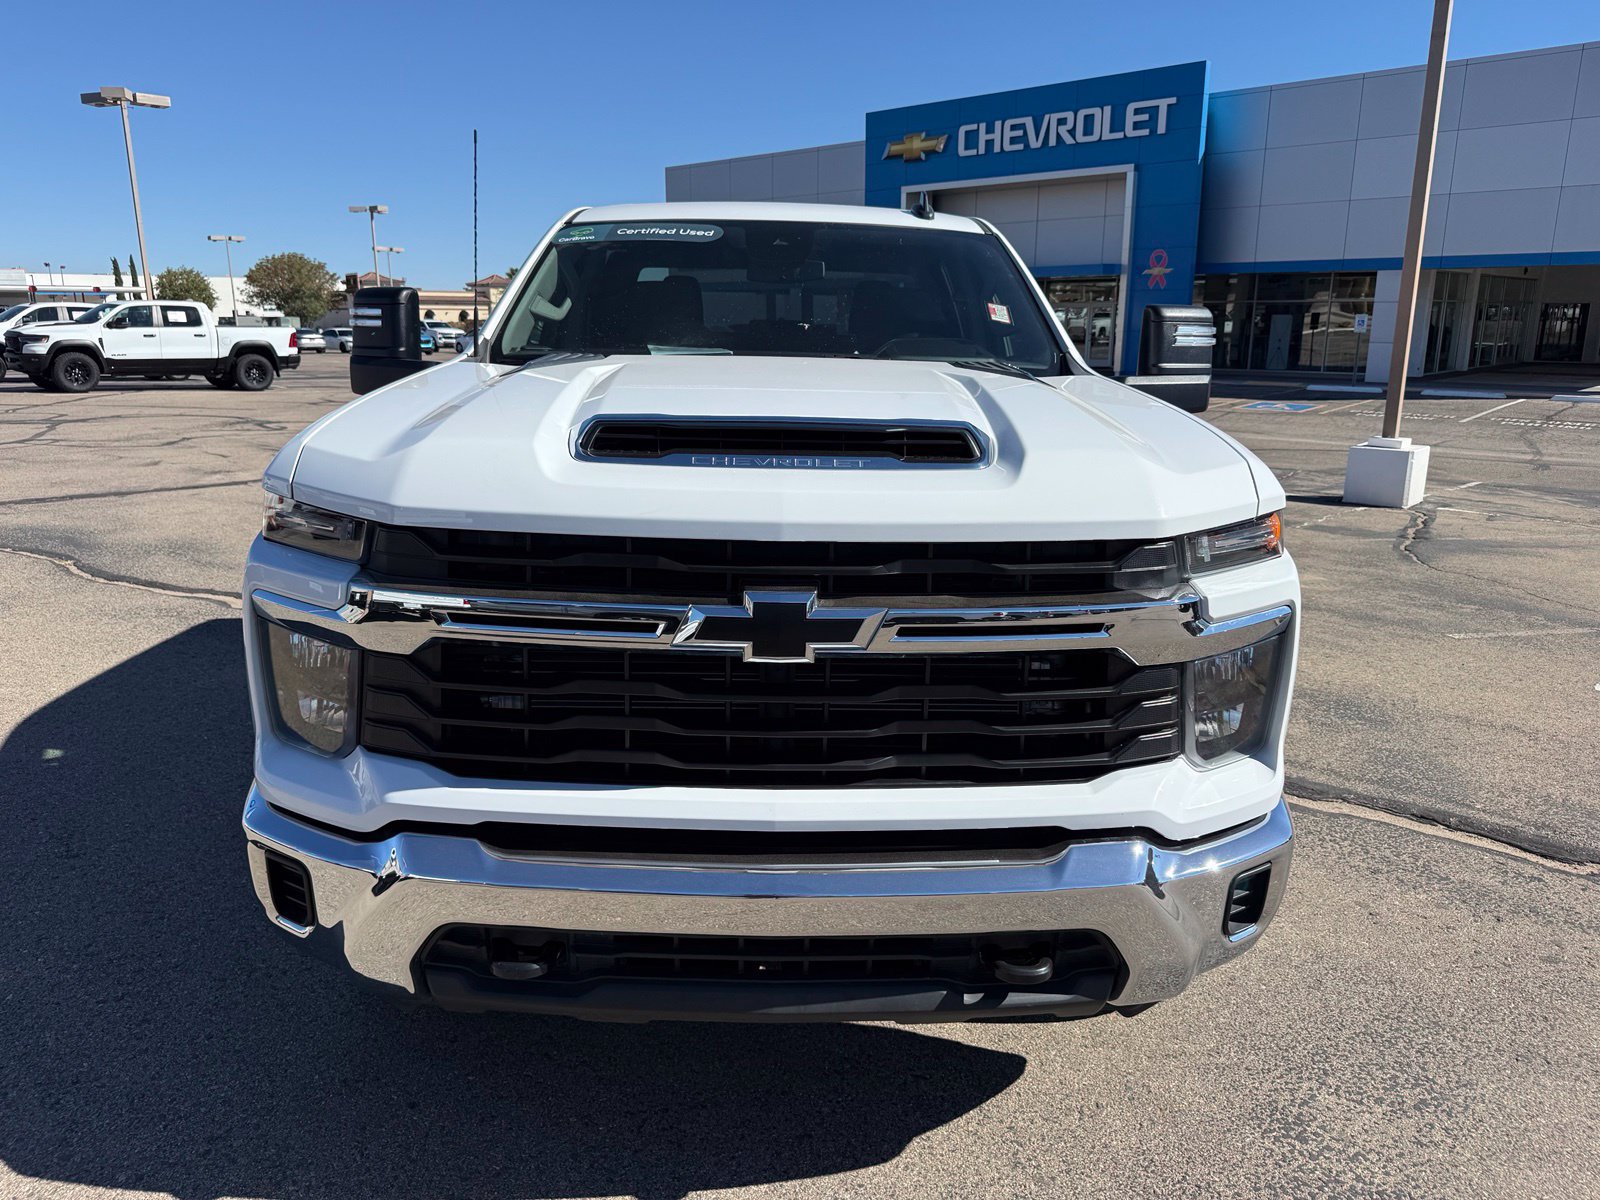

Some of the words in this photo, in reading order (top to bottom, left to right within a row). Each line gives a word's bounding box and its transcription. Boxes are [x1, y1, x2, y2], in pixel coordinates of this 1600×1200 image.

[958, 97, 1177, 157] CHEVROLET
[616, 227, 675, 235] Certified
[679, 228, 715, 237] Used
[691, 456, 871, 468] CHEVROLET
